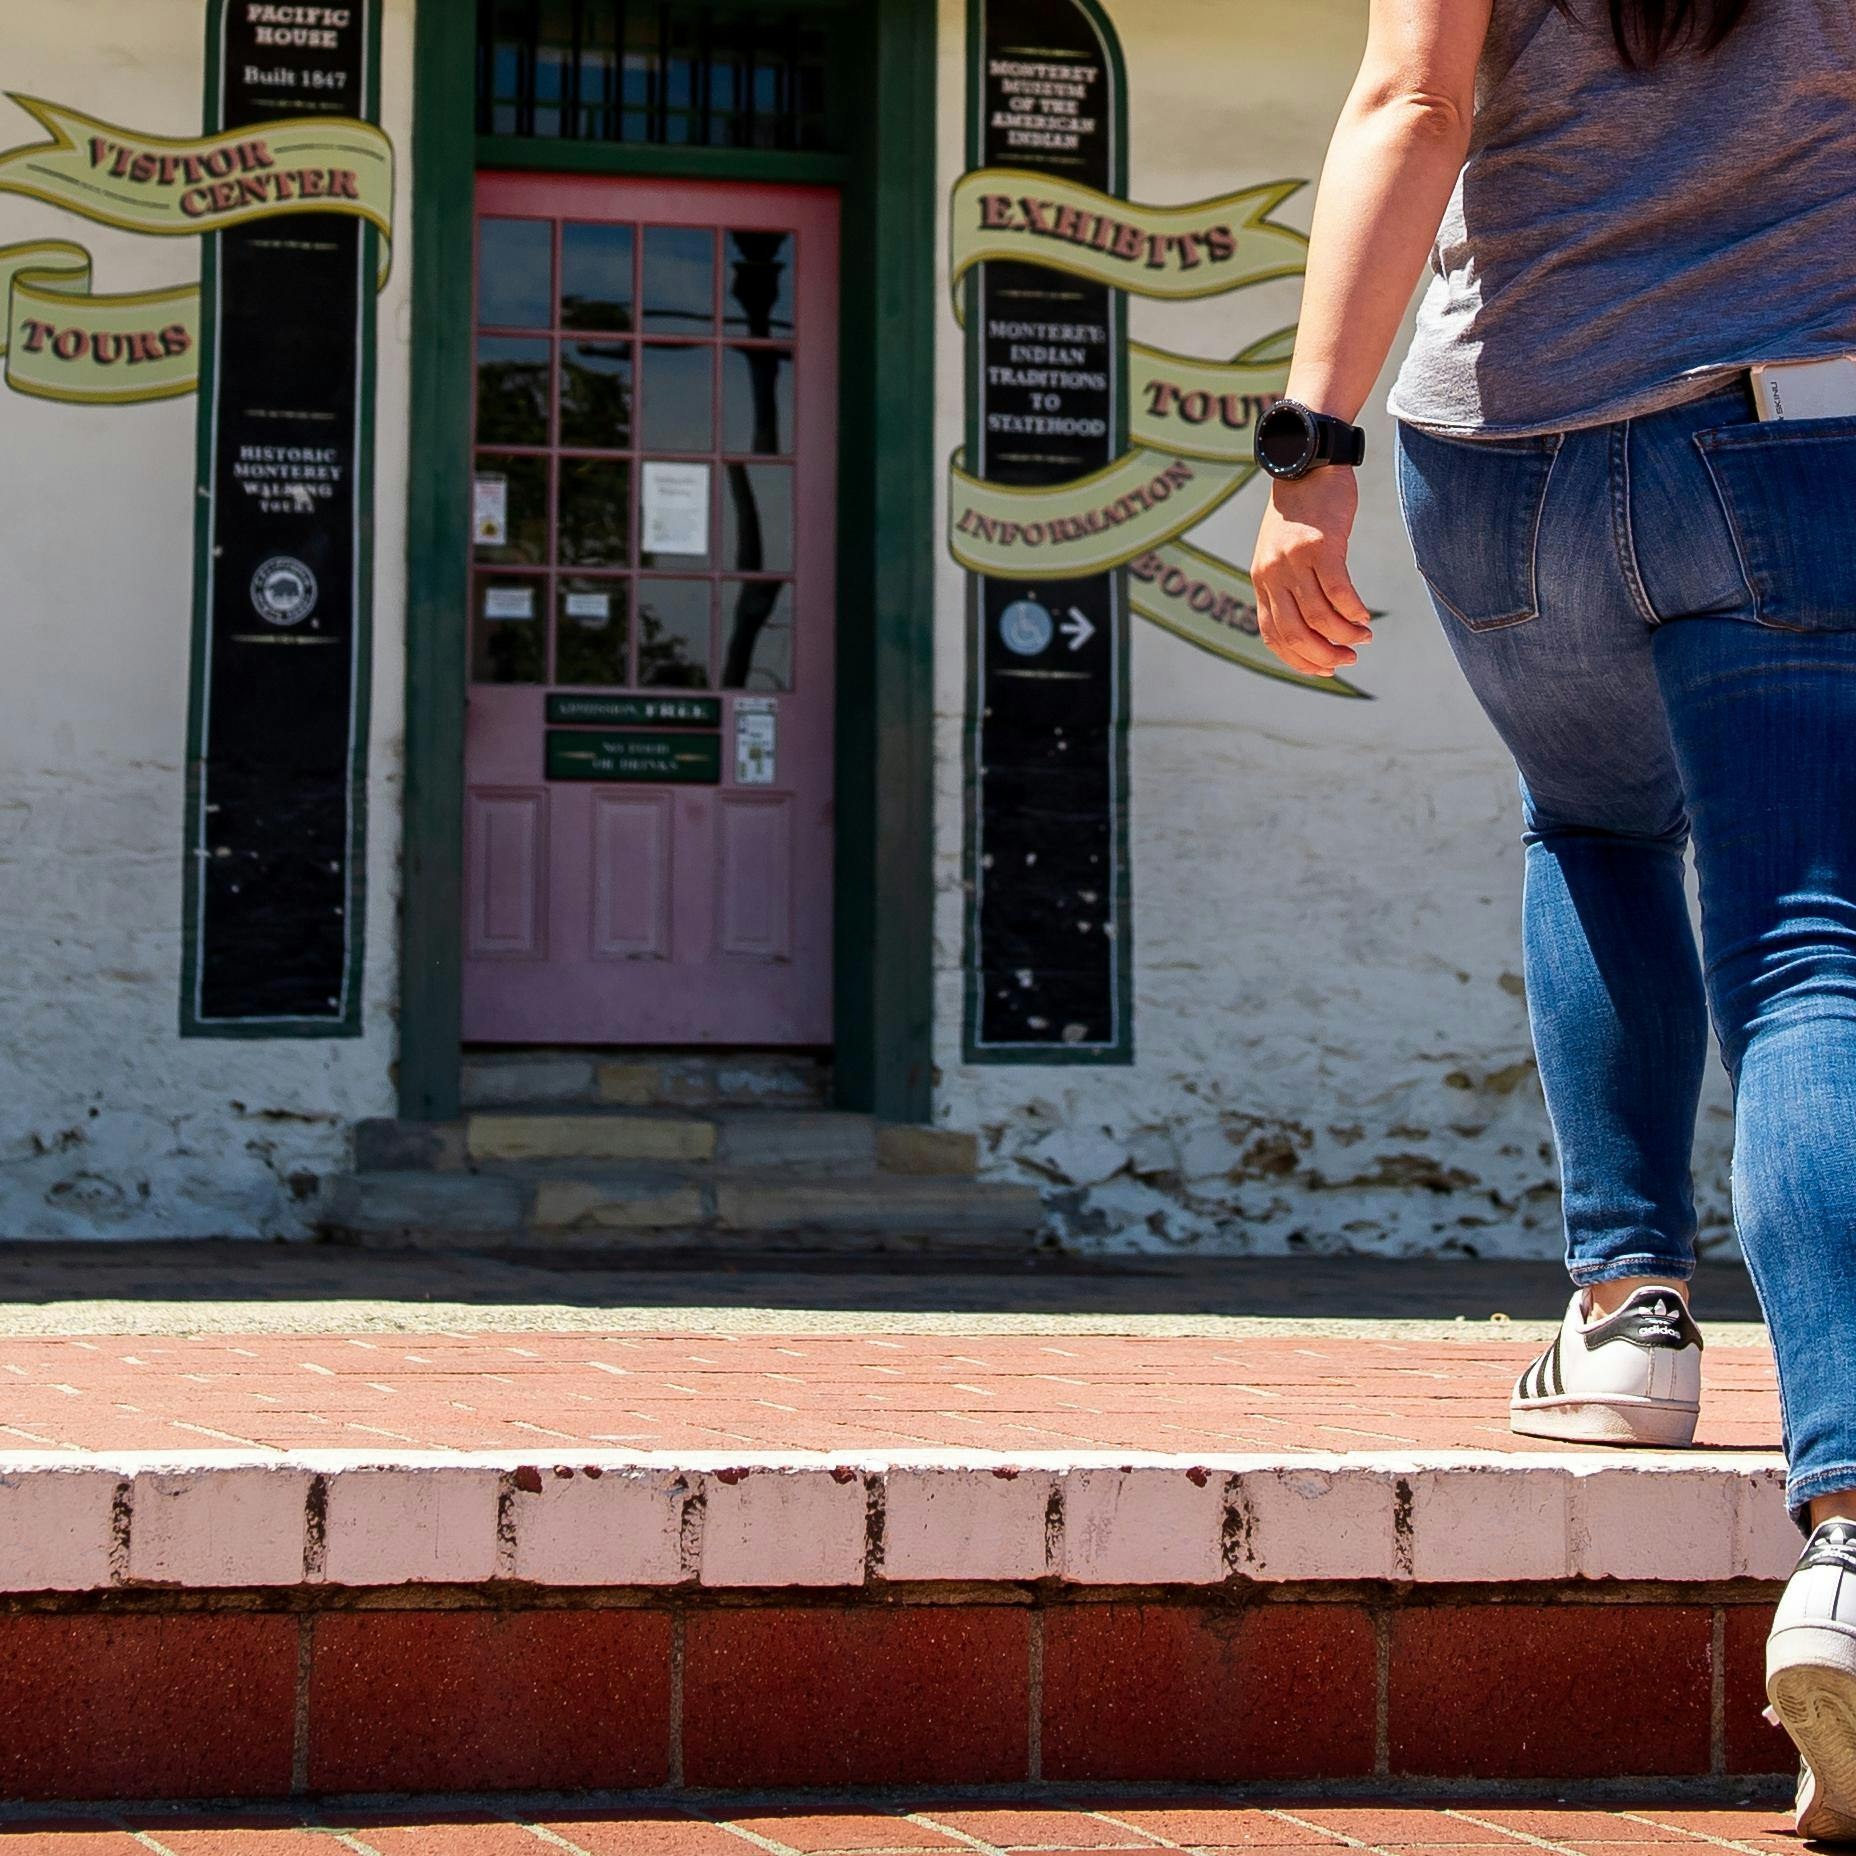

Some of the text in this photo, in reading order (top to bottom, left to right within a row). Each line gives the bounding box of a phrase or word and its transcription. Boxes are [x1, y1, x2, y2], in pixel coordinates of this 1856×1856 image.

[246, 3, 351, 28] PACIFIC
[255, 26, 338, 49] HOUSE
[243, 64, 347, 89] Built 1847
[988, 59, 1099, 83] MONTEREY
[1001, 78, 1087, 100] MUSEUM
[1008, 95, 1080, 115] OF THE
[990, 111, 1096, 134] AMERICAN
[1007, 130, 1080, 150] INDIAN
[89, 137, 275, 185] VISITOR
[180, 168, 360, 218] CENTER
[978, 194, 1238, 270] EXHIBITS
[21, 317, 192, 365] TOURS
[1010, 344, 1086, 364] INDIAN
[987, 366, 1107, 391] TRADITIONS
[1029, 392, 1062, 412] TO
[987, 413, 1106, 437] STATEHOOD
[239, 445, 338, 463] HISTORIC
[233, 462, 343, 481] MONTEREY
[956, 459, 1193, 547] INFORMATION
[1638, 1324, 1682, 1340] adidas
